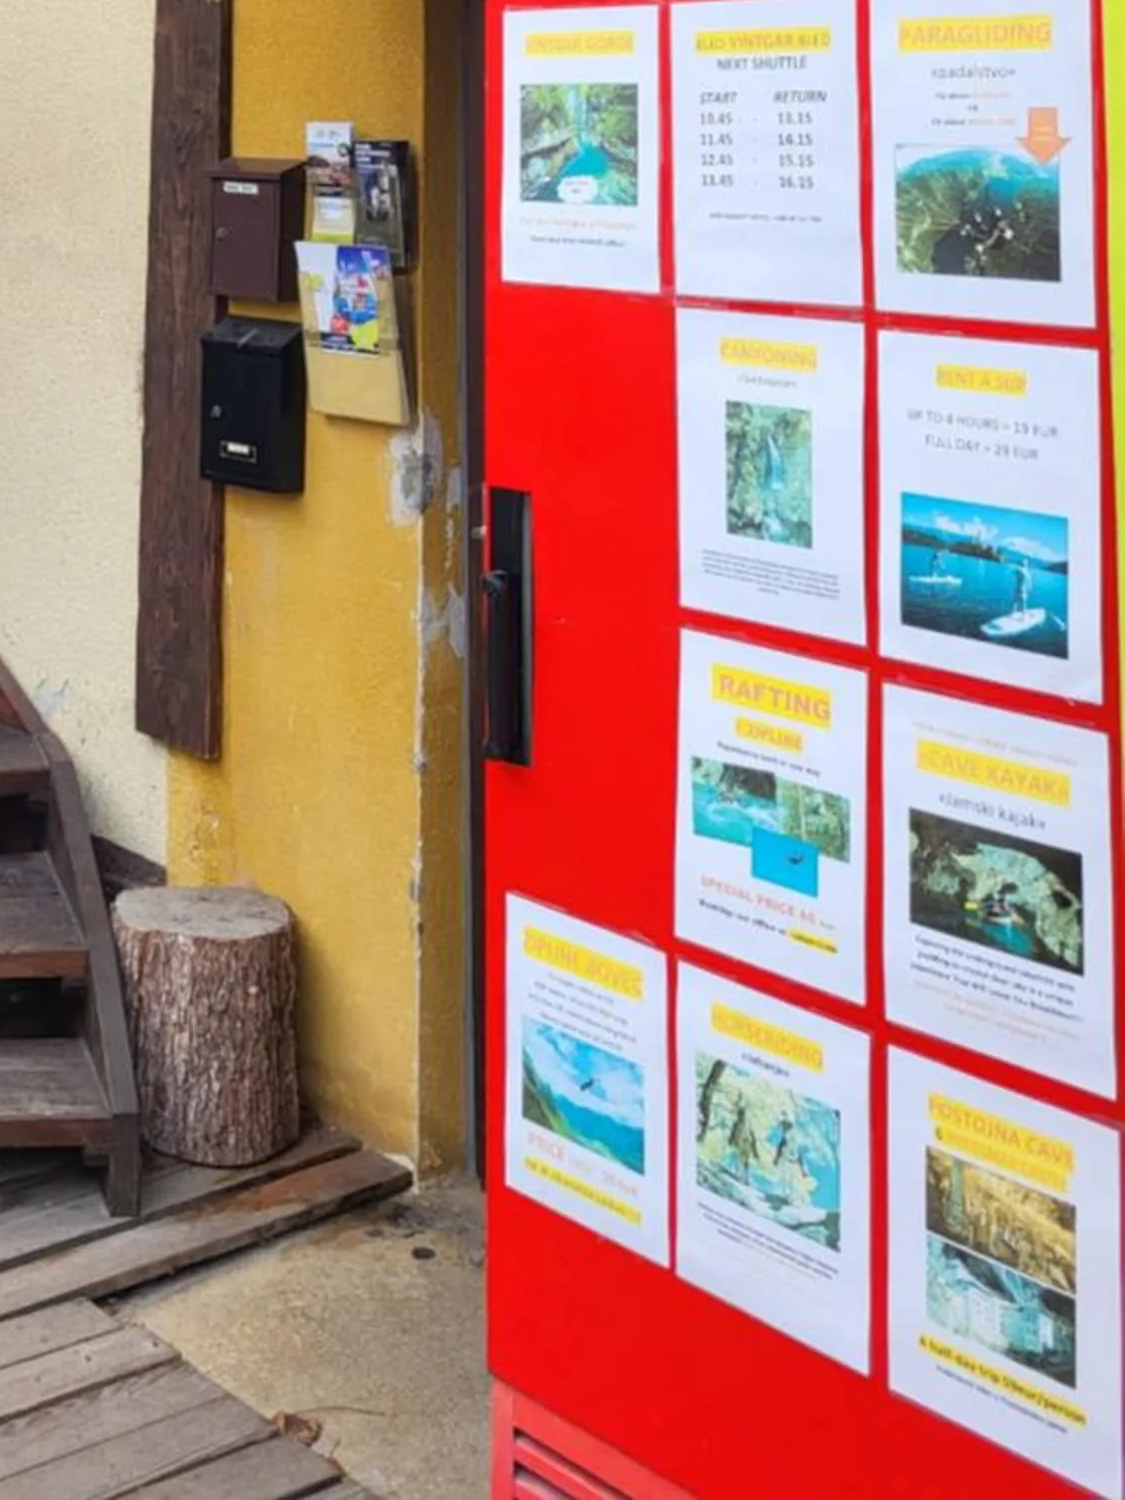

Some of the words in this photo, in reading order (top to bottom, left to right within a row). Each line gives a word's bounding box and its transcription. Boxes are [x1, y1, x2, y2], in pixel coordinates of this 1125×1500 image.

[900, 21, 1052, 46] PARAGLIDING
[716, 57, 748, 71] NEXT
[752, 55, 806, 70] SHUTTLE
[699, 90, 738, 105] START
[773, 90, 827, 103] RETURN
[699, 112, 733, 126] 10.45
[700, 133, 734, 147] 11.45
[925, 409, 943, 424] TO
[956, 414, 999, 432] HOURS
[719, 673, 831, 722] RAFTING
